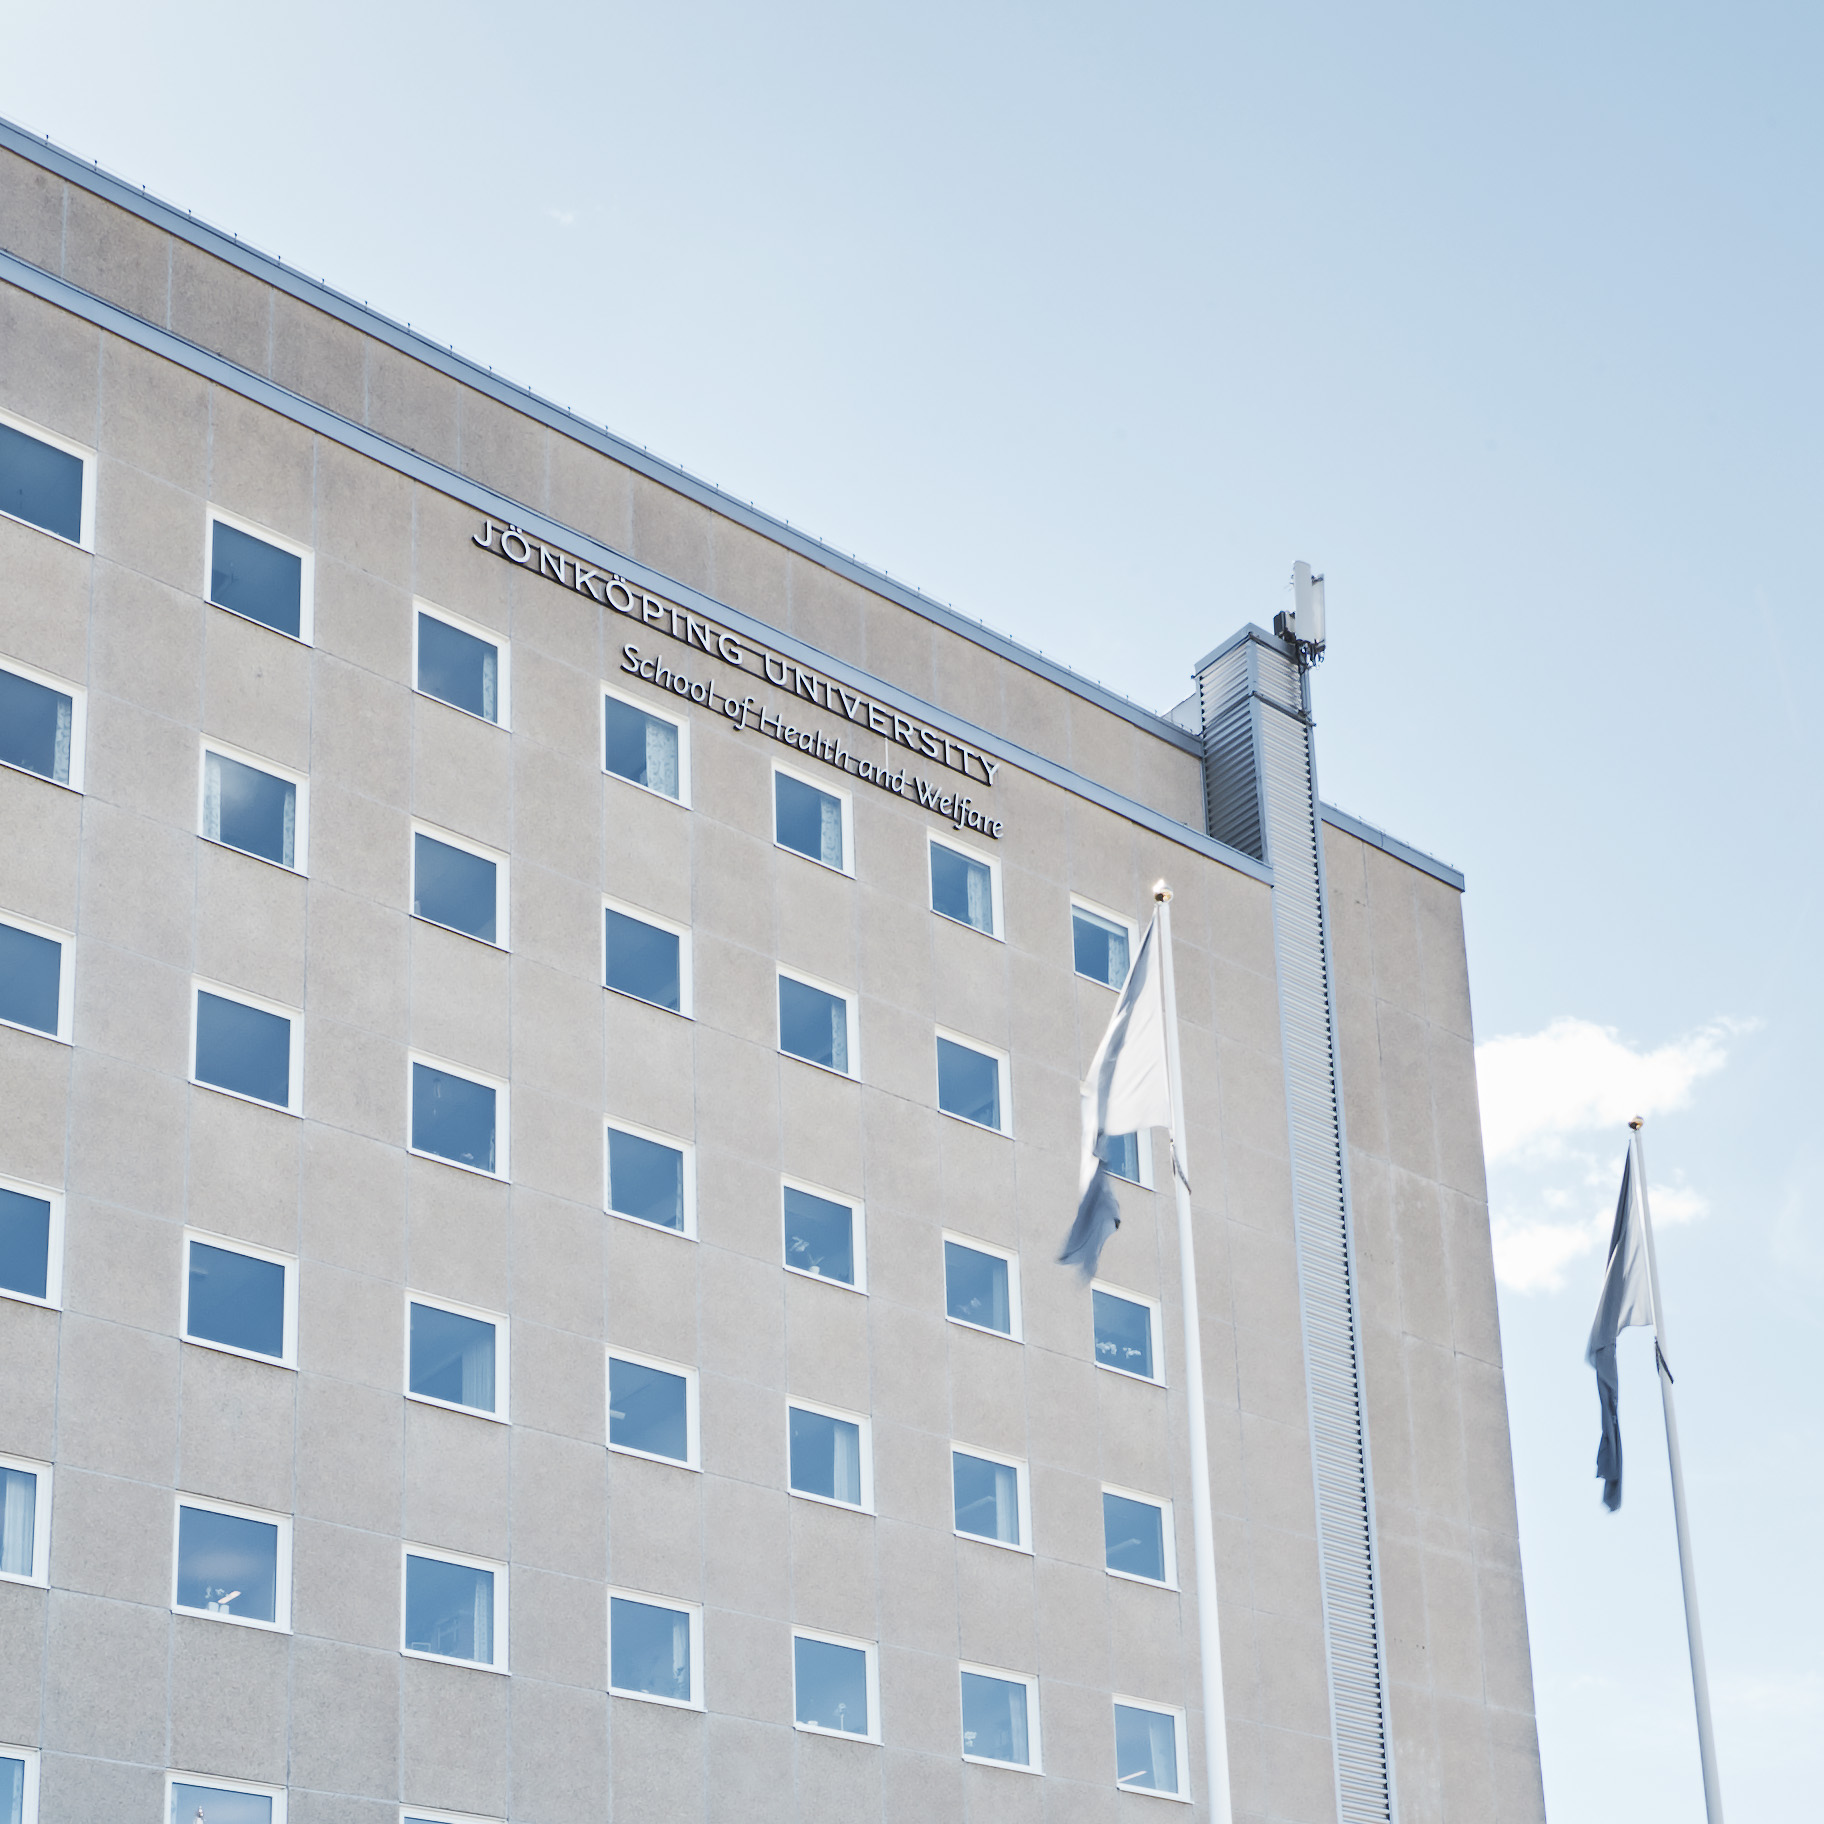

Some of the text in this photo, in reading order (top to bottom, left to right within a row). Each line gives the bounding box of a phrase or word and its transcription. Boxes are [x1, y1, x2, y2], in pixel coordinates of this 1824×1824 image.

[472, 518, 1002, 786] JÖNKÖPING UNIVERSITY
[620, 643, 1004, 839] School of Health and Welfare
